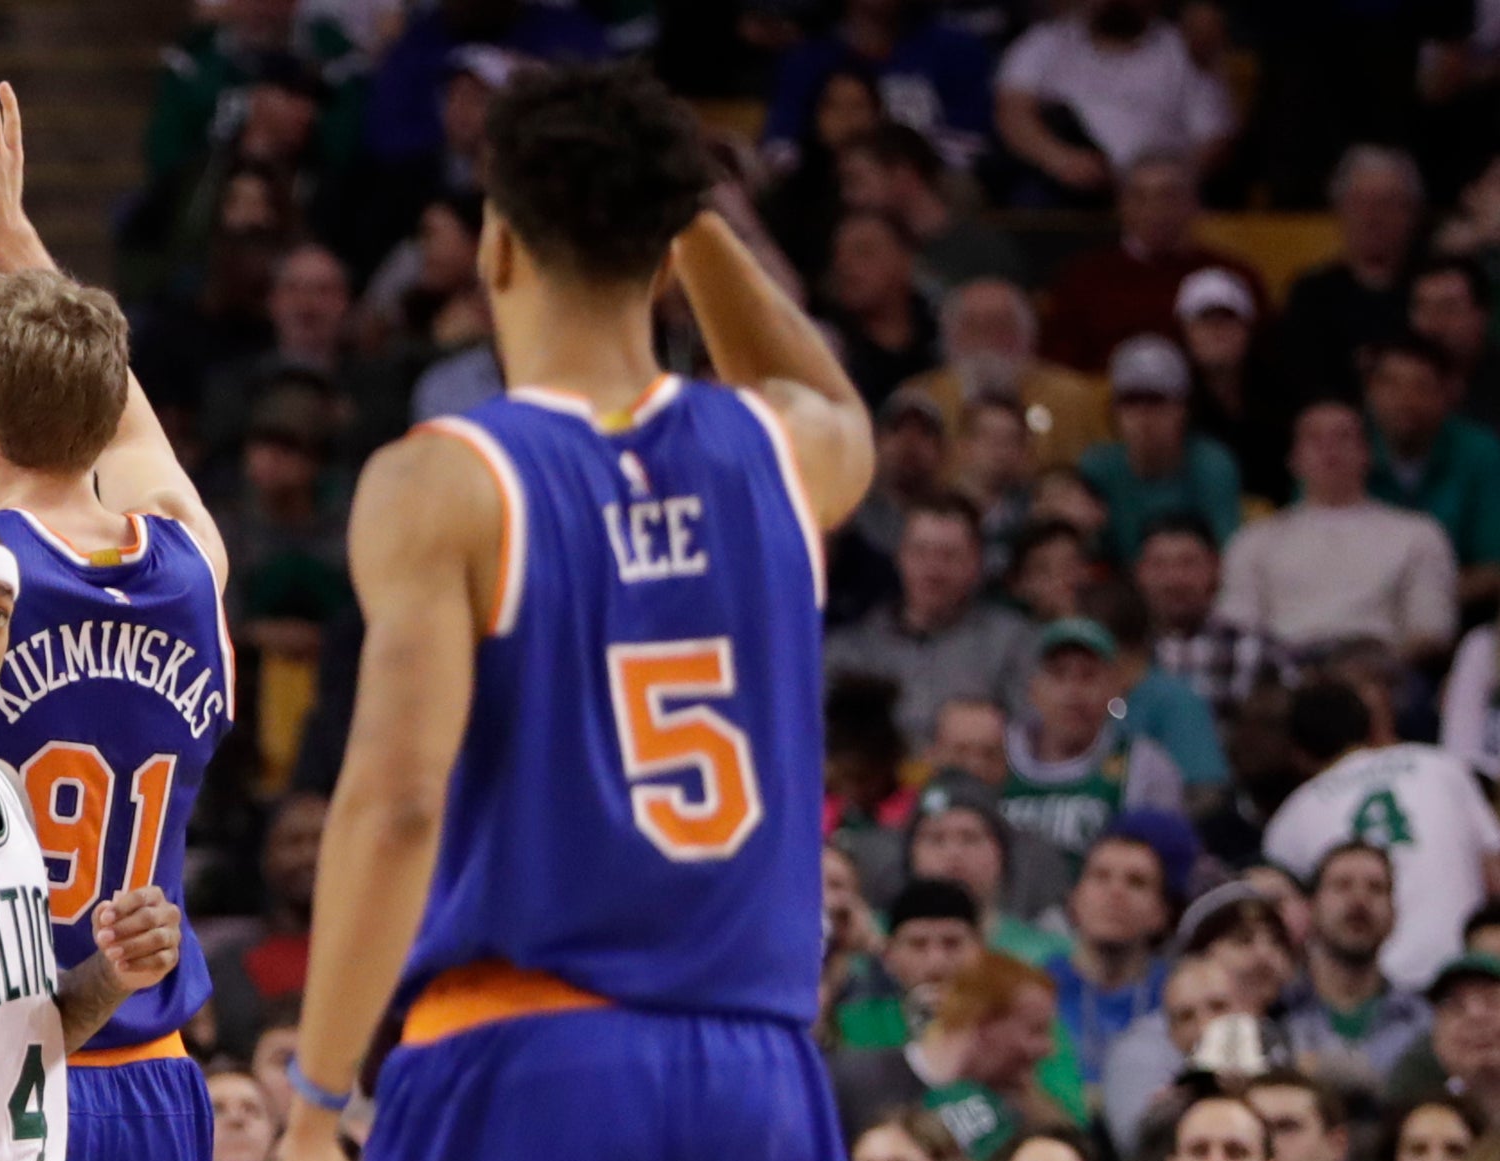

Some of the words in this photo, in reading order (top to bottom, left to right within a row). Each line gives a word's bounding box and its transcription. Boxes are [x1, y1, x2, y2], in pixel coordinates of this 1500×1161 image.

[603, 495, 708, 584] LEE
[19, 740, 178, 925] 91
[606, 636, 764, 864] 5
